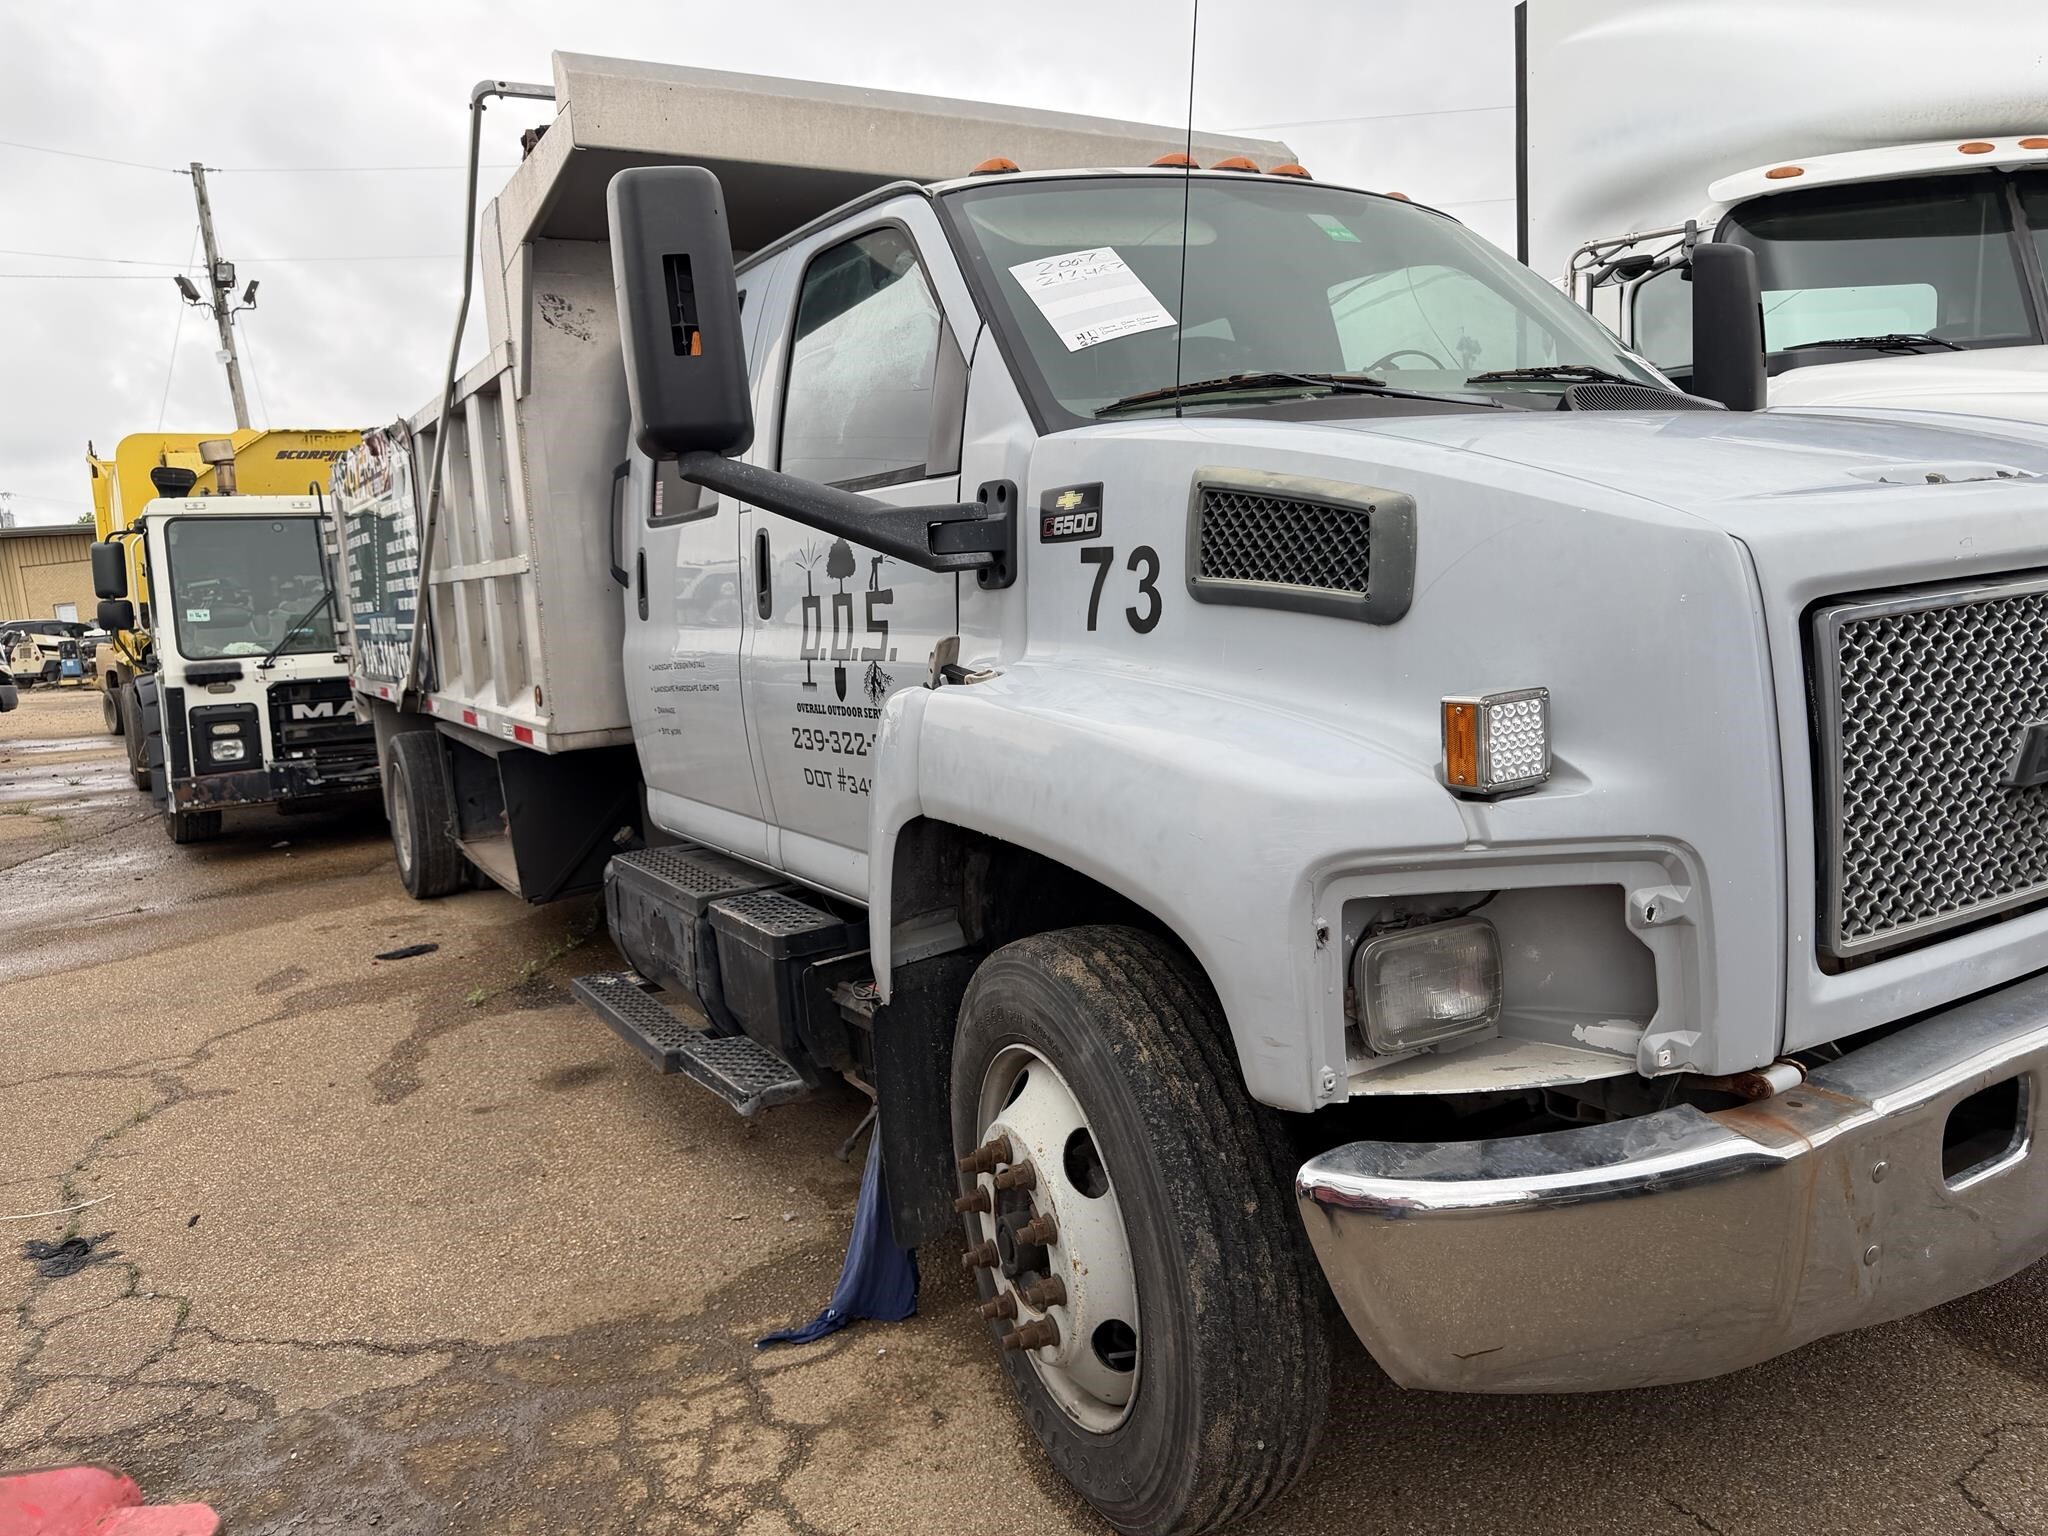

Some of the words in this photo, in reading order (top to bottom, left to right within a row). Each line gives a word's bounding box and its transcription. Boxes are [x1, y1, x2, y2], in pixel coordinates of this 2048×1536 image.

[1042, 512, 1098, 537] C6500
[1080, 545, 1162, 634] 73
[796, 702, 827, 716] OVERALL
[827, 704, 864, 720] OUTDOOR
[803, 767, 833, 790] DOT
